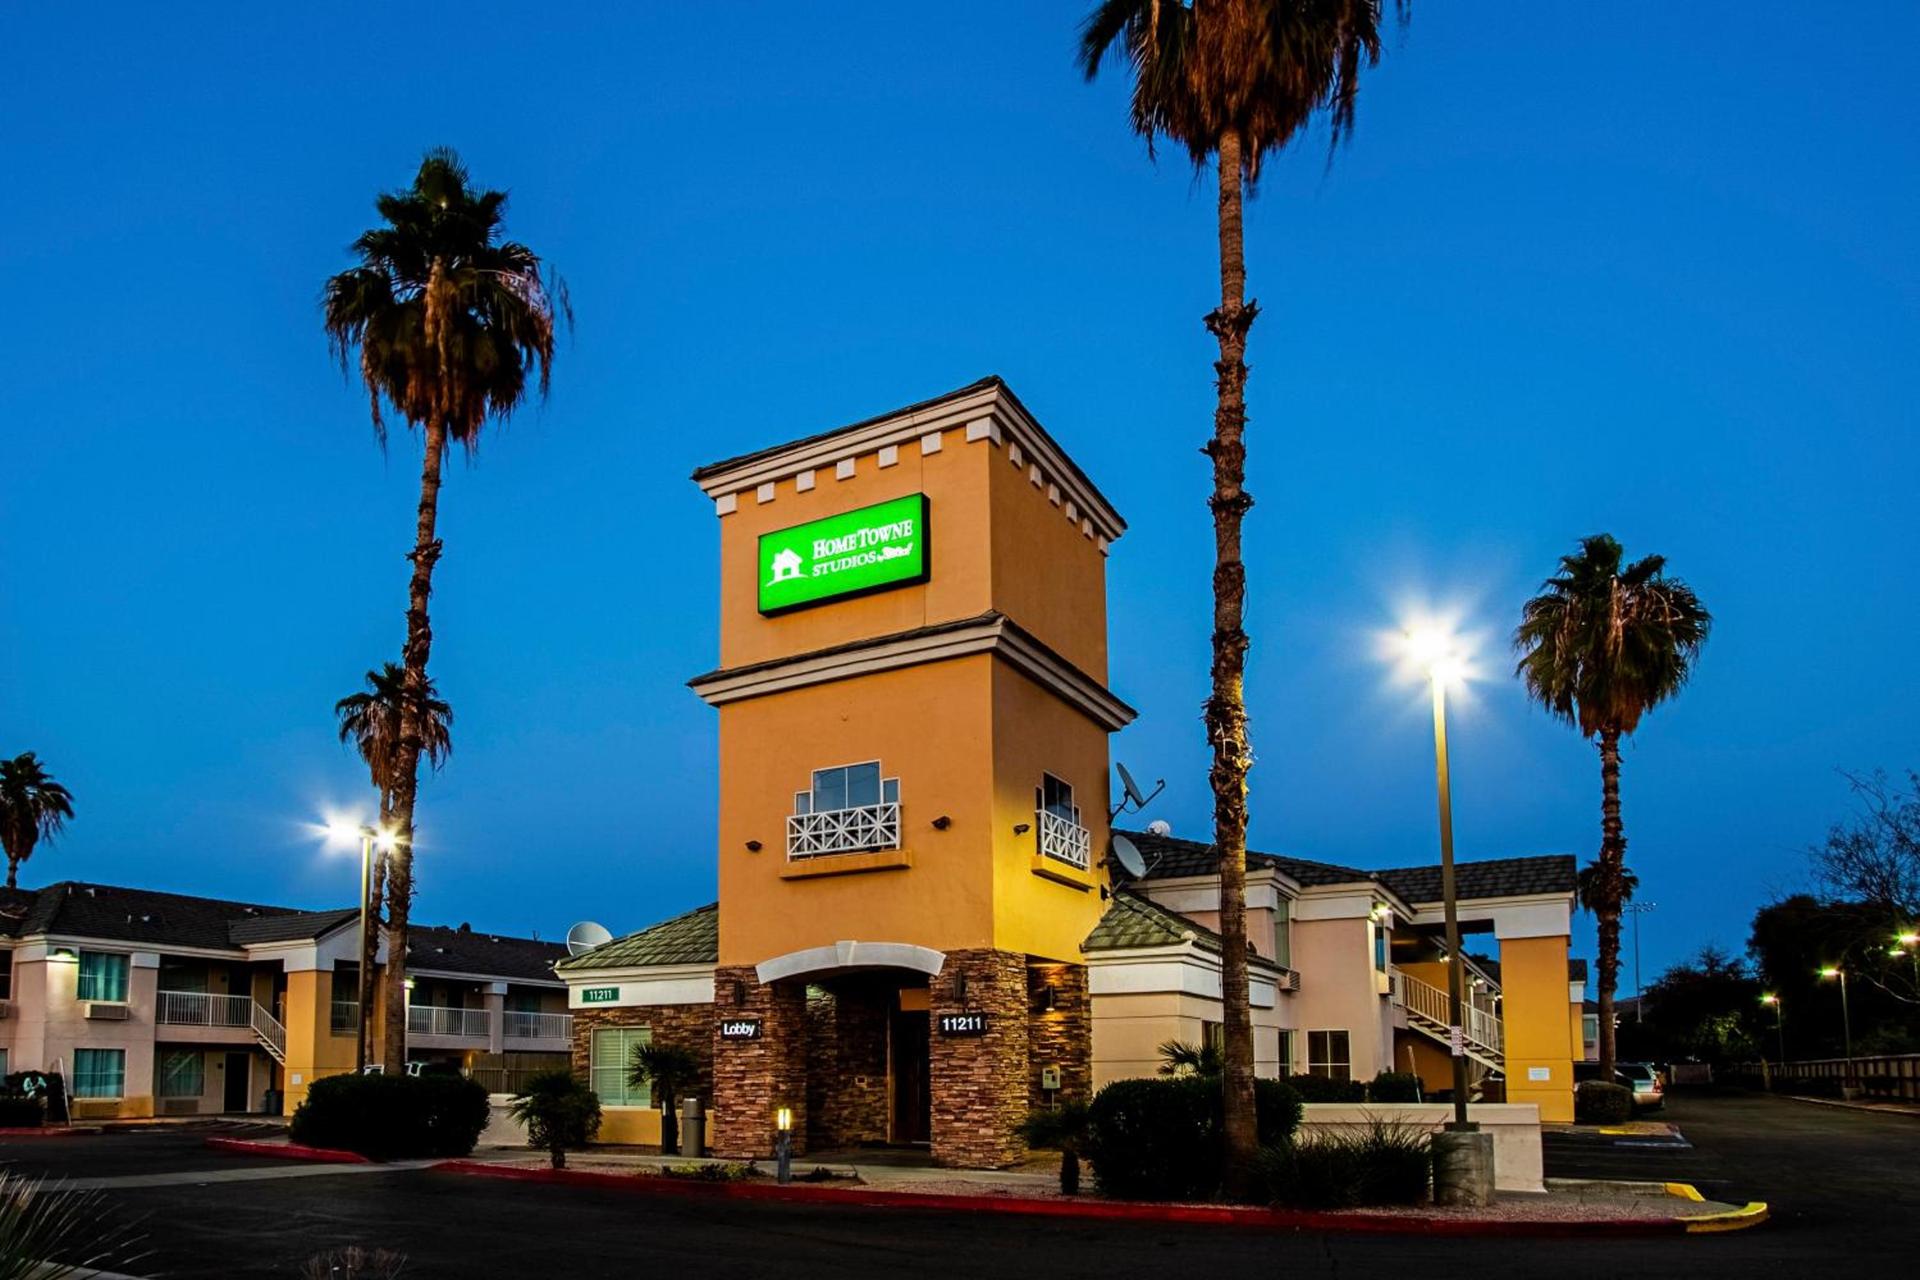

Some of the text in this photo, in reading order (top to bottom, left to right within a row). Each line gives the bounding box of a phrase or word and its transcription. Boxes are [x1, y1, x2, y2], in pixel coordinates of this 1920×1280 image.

[812, 550, 876, 577] STUDIOS
[589, 989, 612, 1001] 11211
[723, 1022, 755, 1037] Lobby
[942, 1016, 981, 1031] 11211
